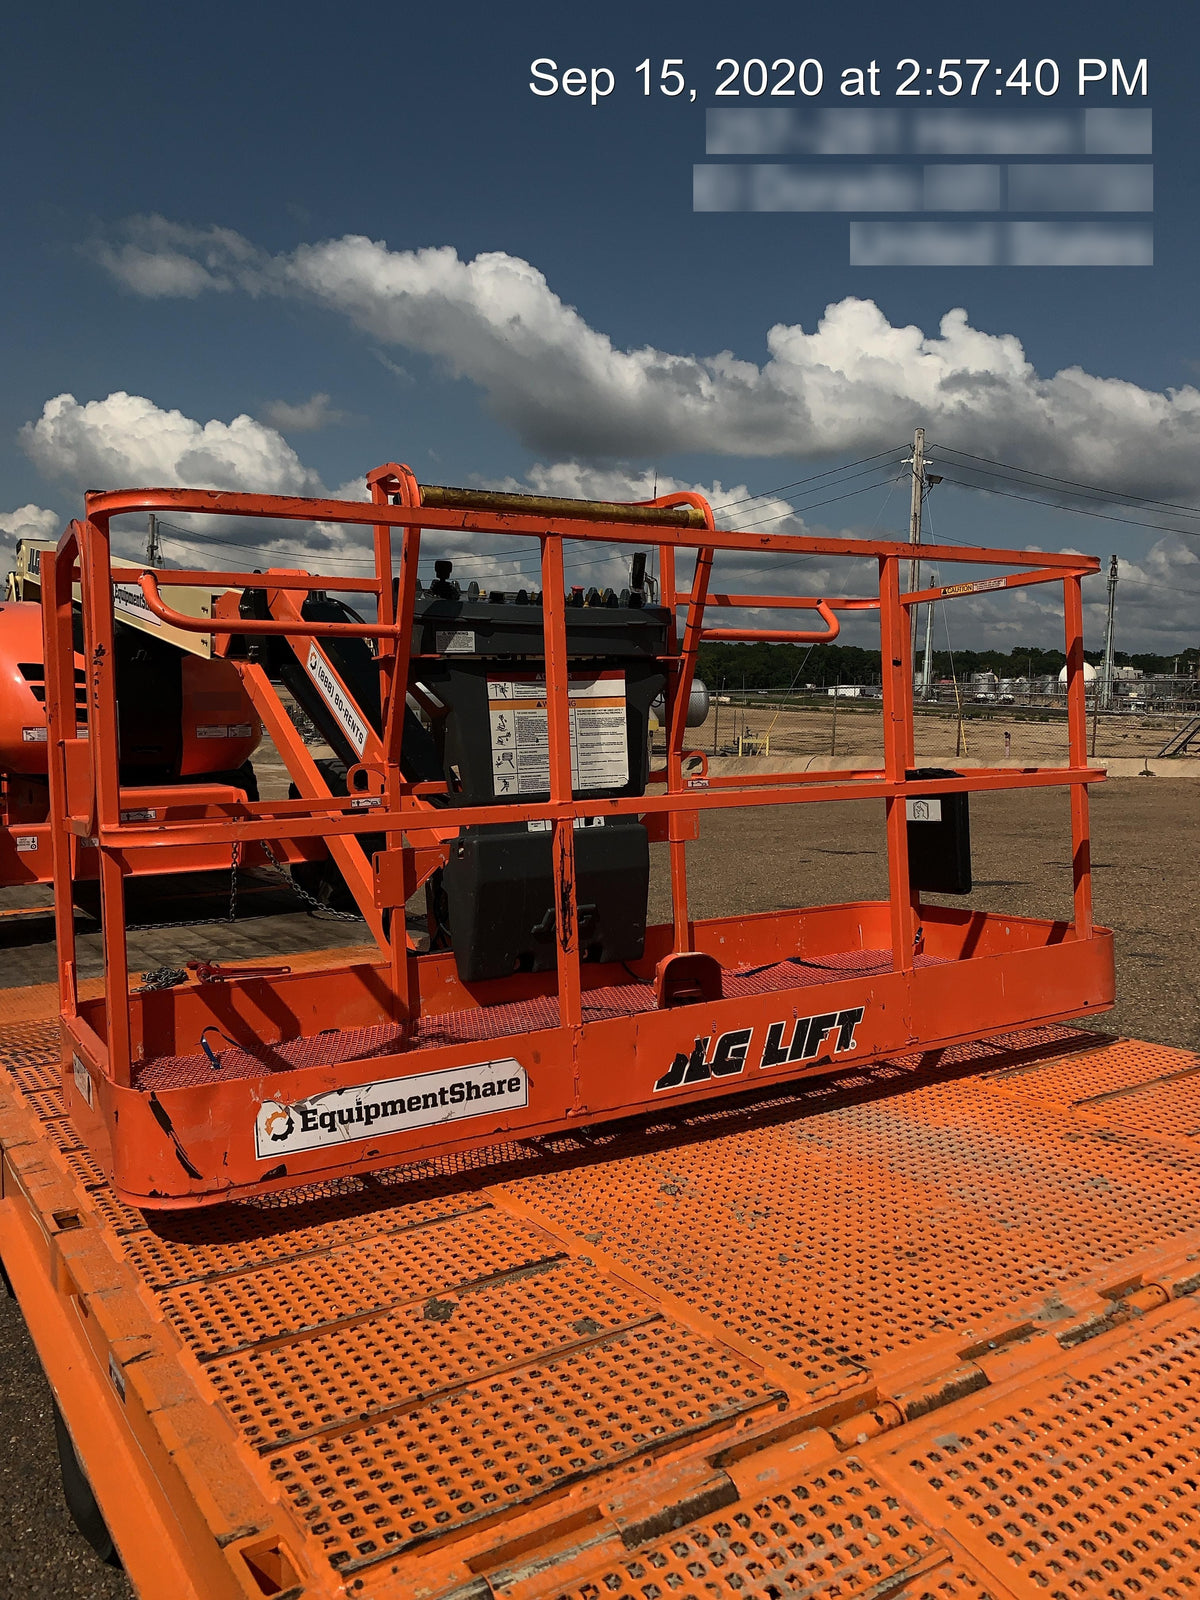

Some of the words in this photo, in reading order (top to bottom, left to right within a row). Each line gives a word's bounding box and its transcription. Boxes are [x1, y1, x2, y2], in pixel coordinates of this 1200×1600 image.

[317, 666, 335, 698] (888)
[334, 693, 364, 745] 80-RENTS
[653, 1027, 754, 1093] JLG
[759, 1006, 865, 1069] LIFT
[300, 1076, 521, 1133] EquipmentShare
